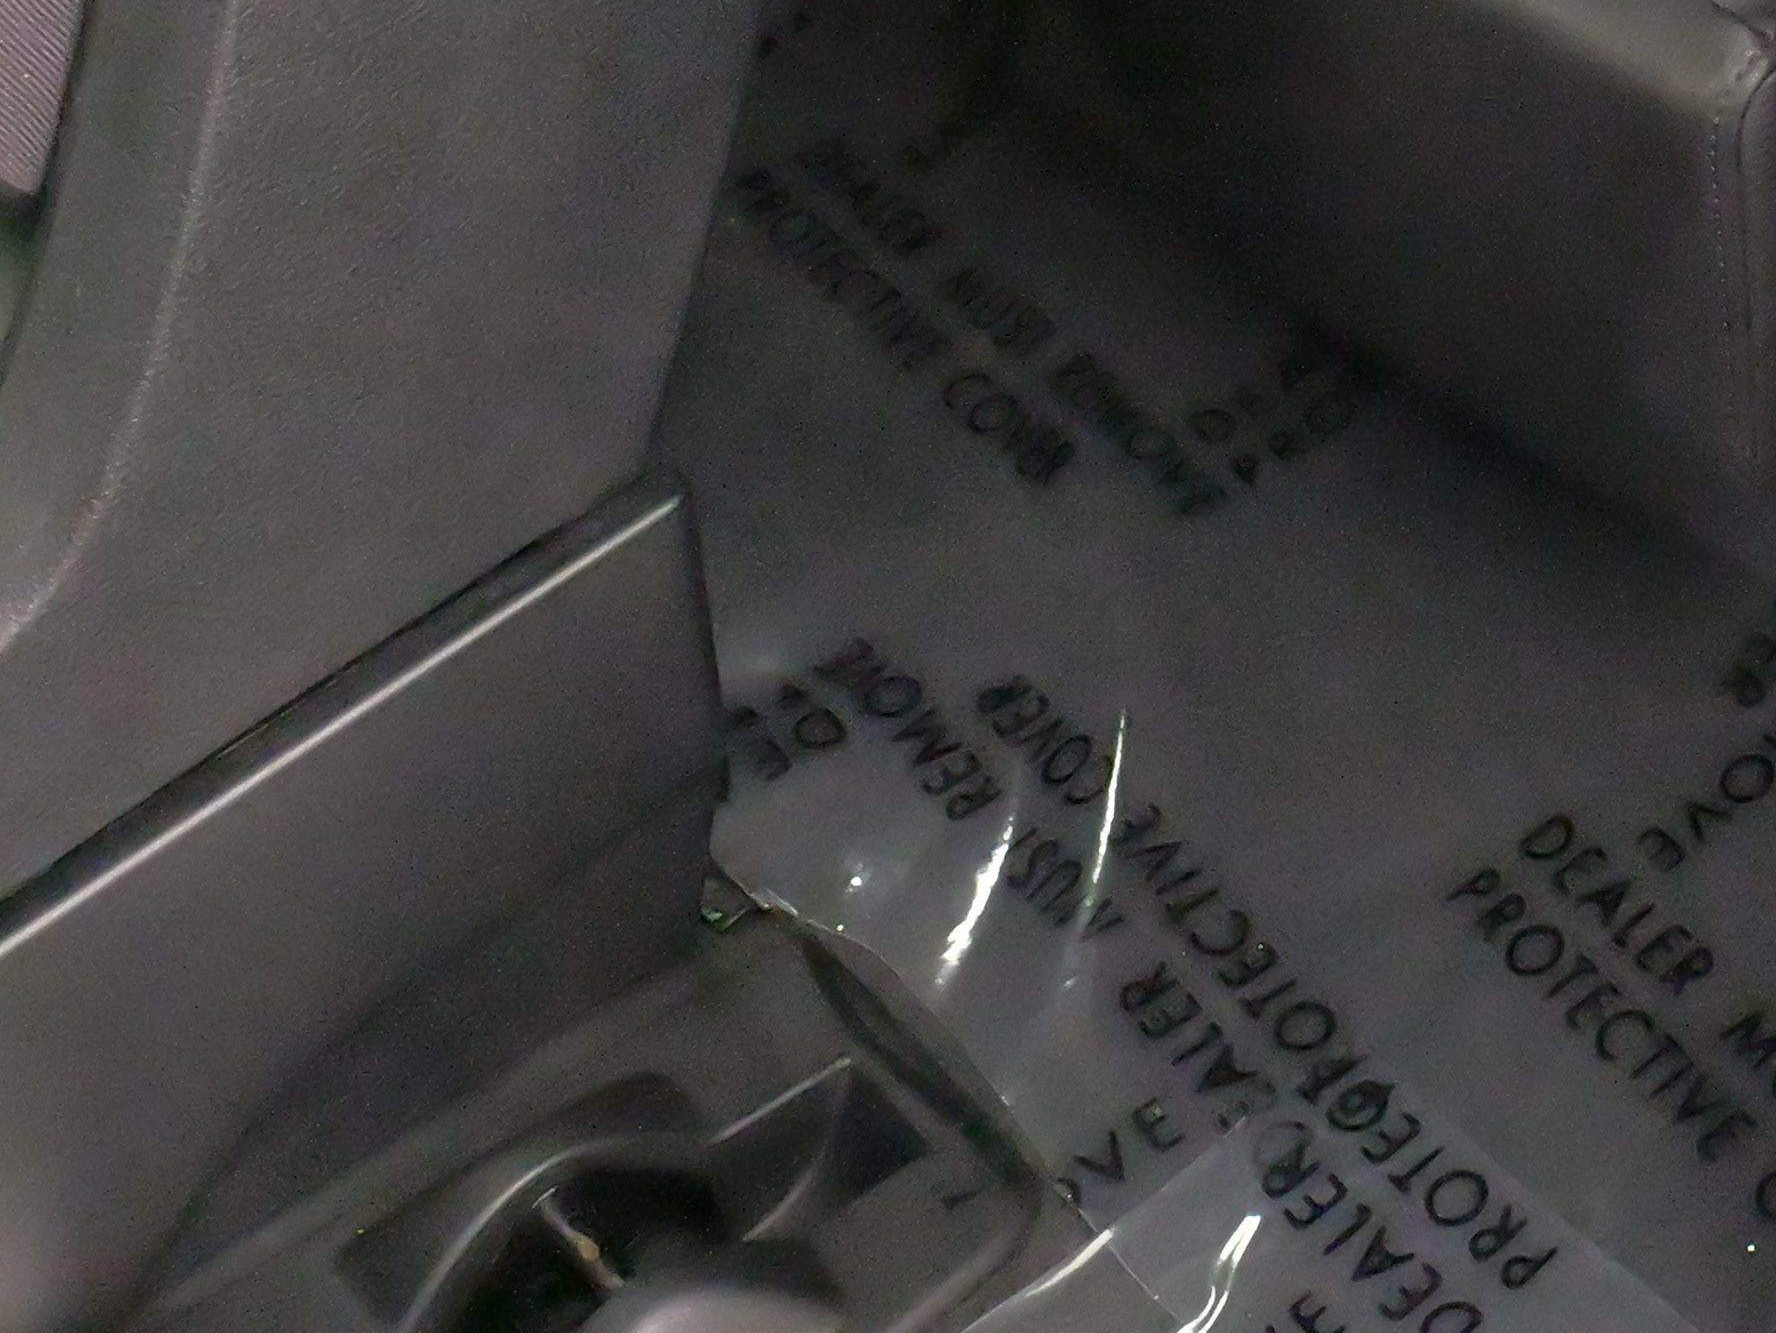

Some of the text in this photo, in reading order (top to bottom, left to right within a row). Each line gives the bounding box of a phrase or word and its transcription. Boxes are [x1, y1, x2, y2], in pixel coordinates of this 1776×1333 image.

[976, 675, 1114, 806] COVER
[1517, 813, 1714, 997] DEALER
[1446, 866, 1759, 1162] PROTECTIVE
